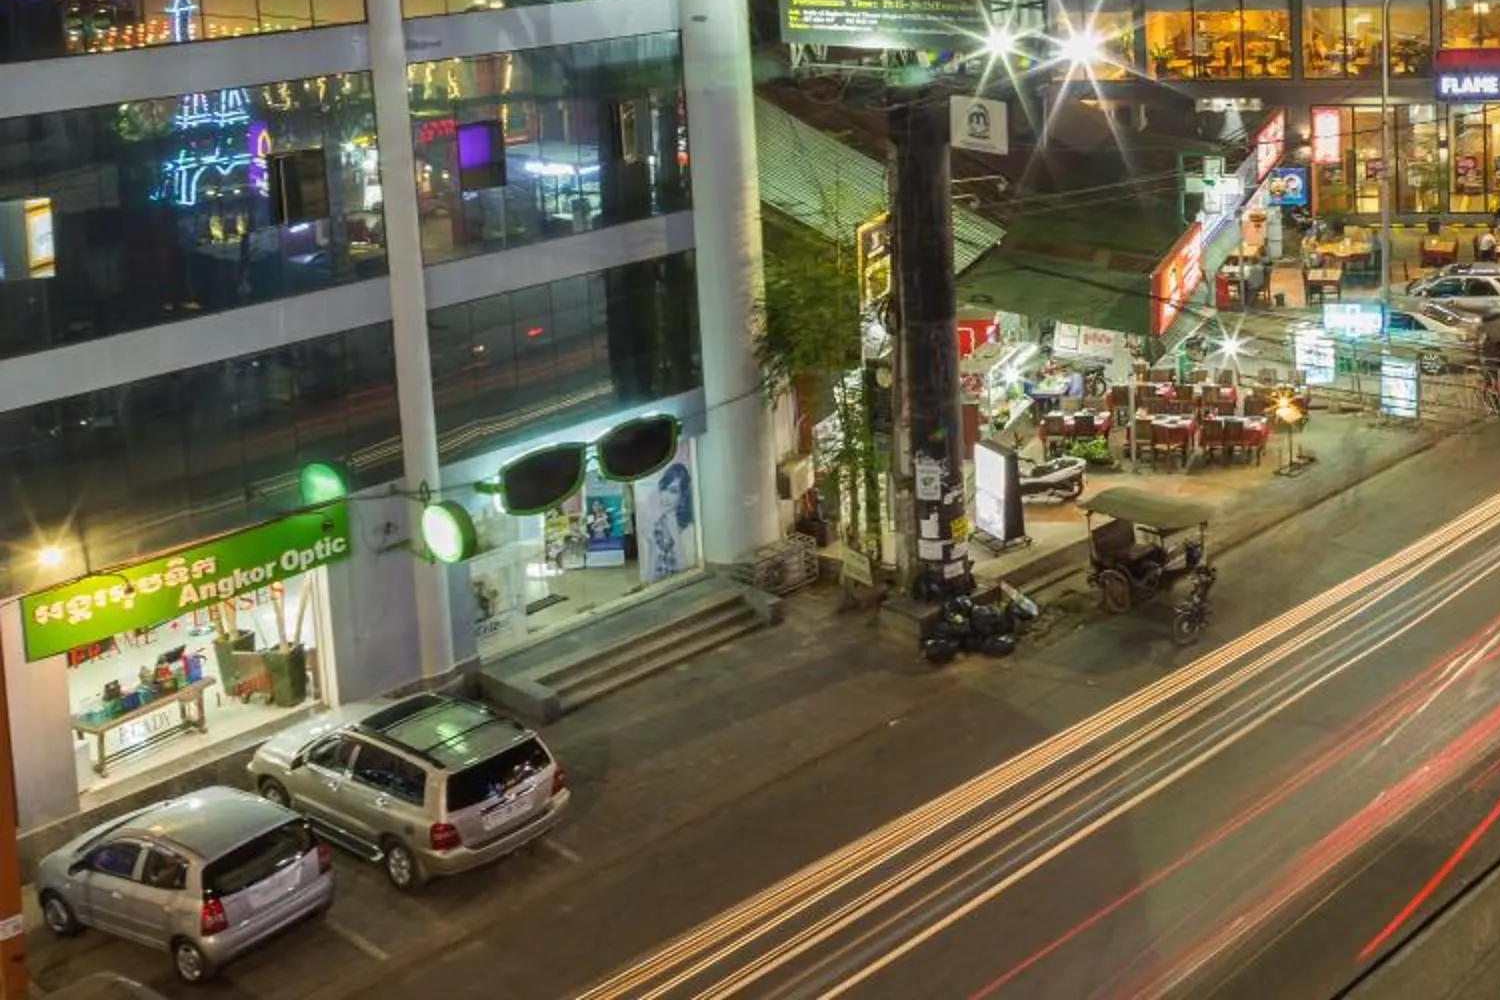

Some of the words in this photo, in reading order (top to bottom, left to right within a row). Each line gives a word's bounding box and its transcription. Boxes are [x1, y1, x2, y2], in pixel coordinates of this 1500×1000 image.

[1441, 76, 1498, 93] FLAME
[179, 559, 277, 608] Angkor
[280, 535, 348, 572] Optic
